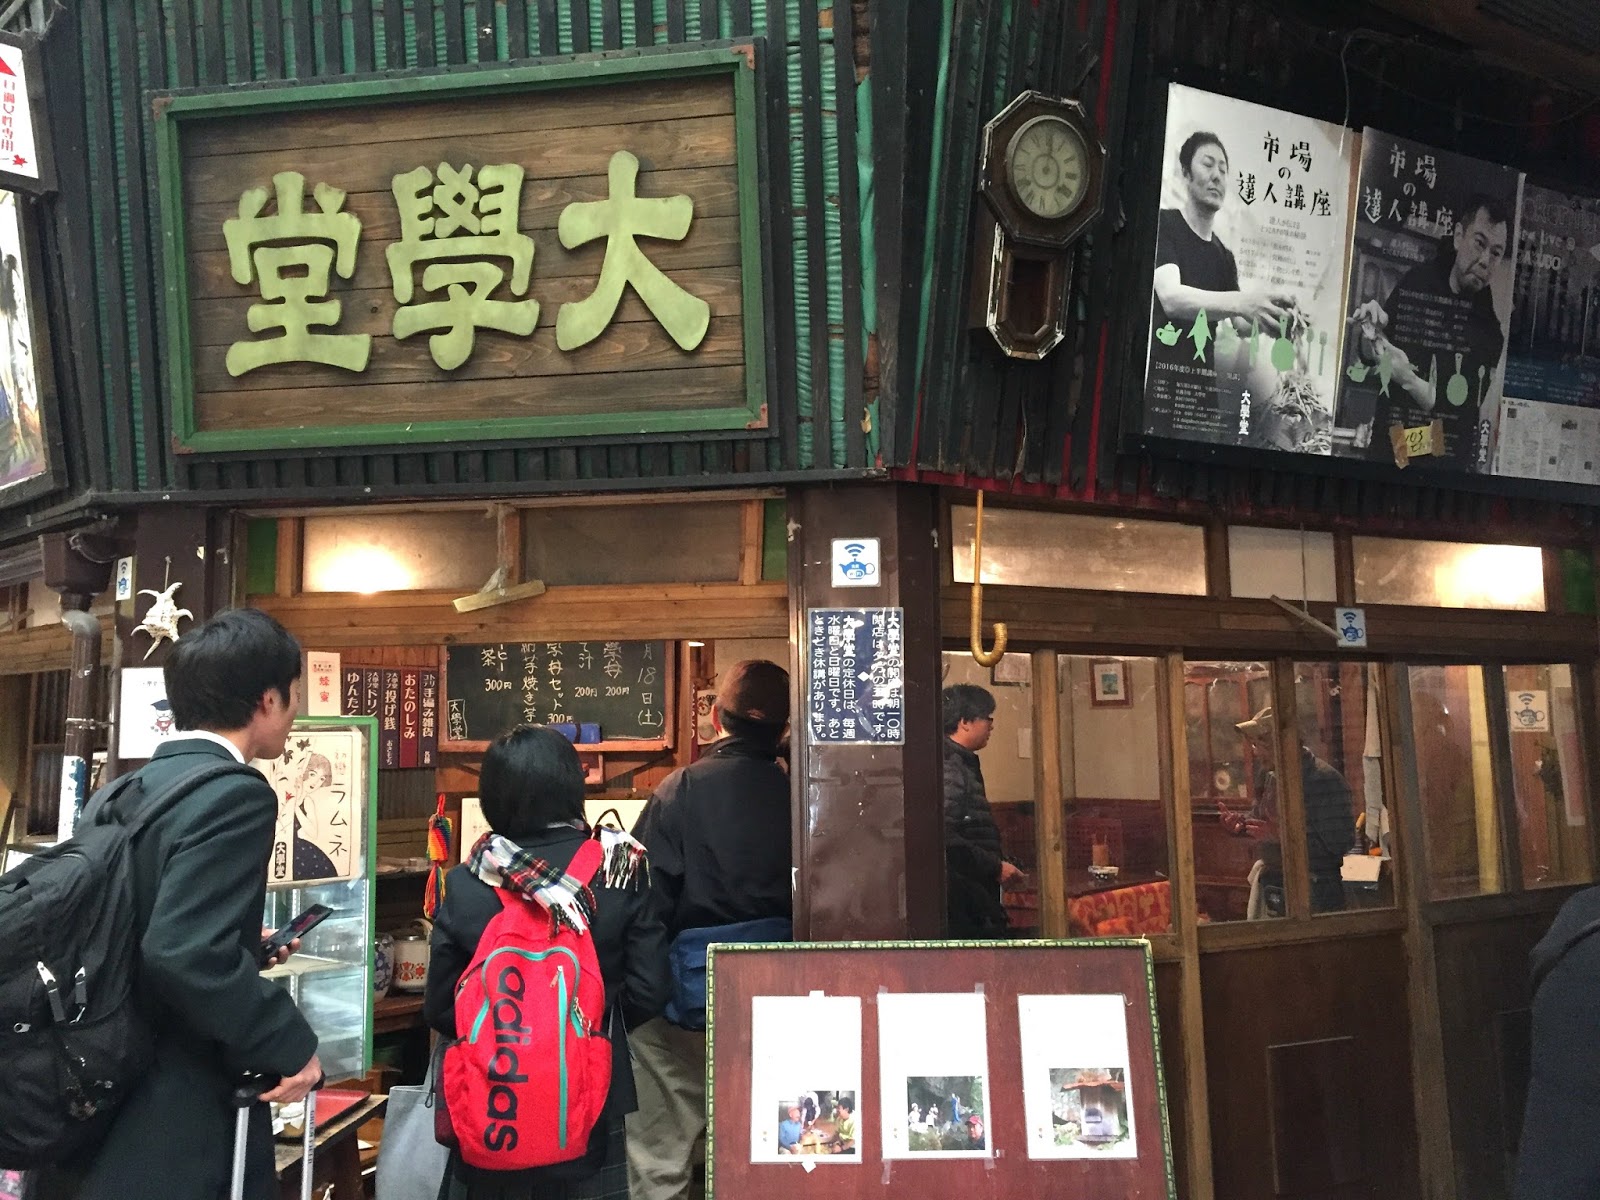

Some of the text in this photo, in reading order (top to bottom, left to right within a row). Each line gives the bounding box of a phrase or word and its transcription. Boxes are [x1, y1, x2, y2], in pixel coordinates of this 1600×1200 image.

[1263, 130, 1312, 173] 市場
[1278, 166, 1291, 180] の
[1390, 143, 1437, 189] 市場
[1236, 171, 1332, 217] 達人講座
[1363, 186, 1454, 237] 達人講座
[1403, 182, 1416, 196] の
[222, 149, 711, 378] 大學堂
[403, 674, 416, 739] おたのしみ
[484, 679, 512, 691] 300円
[605, 686, 630, 697] 200円
[384, 689, 397, 730] 投げ銭
[329, 783, 348, 857] ラムネ
[483, 966, 528, 1152] adidas
